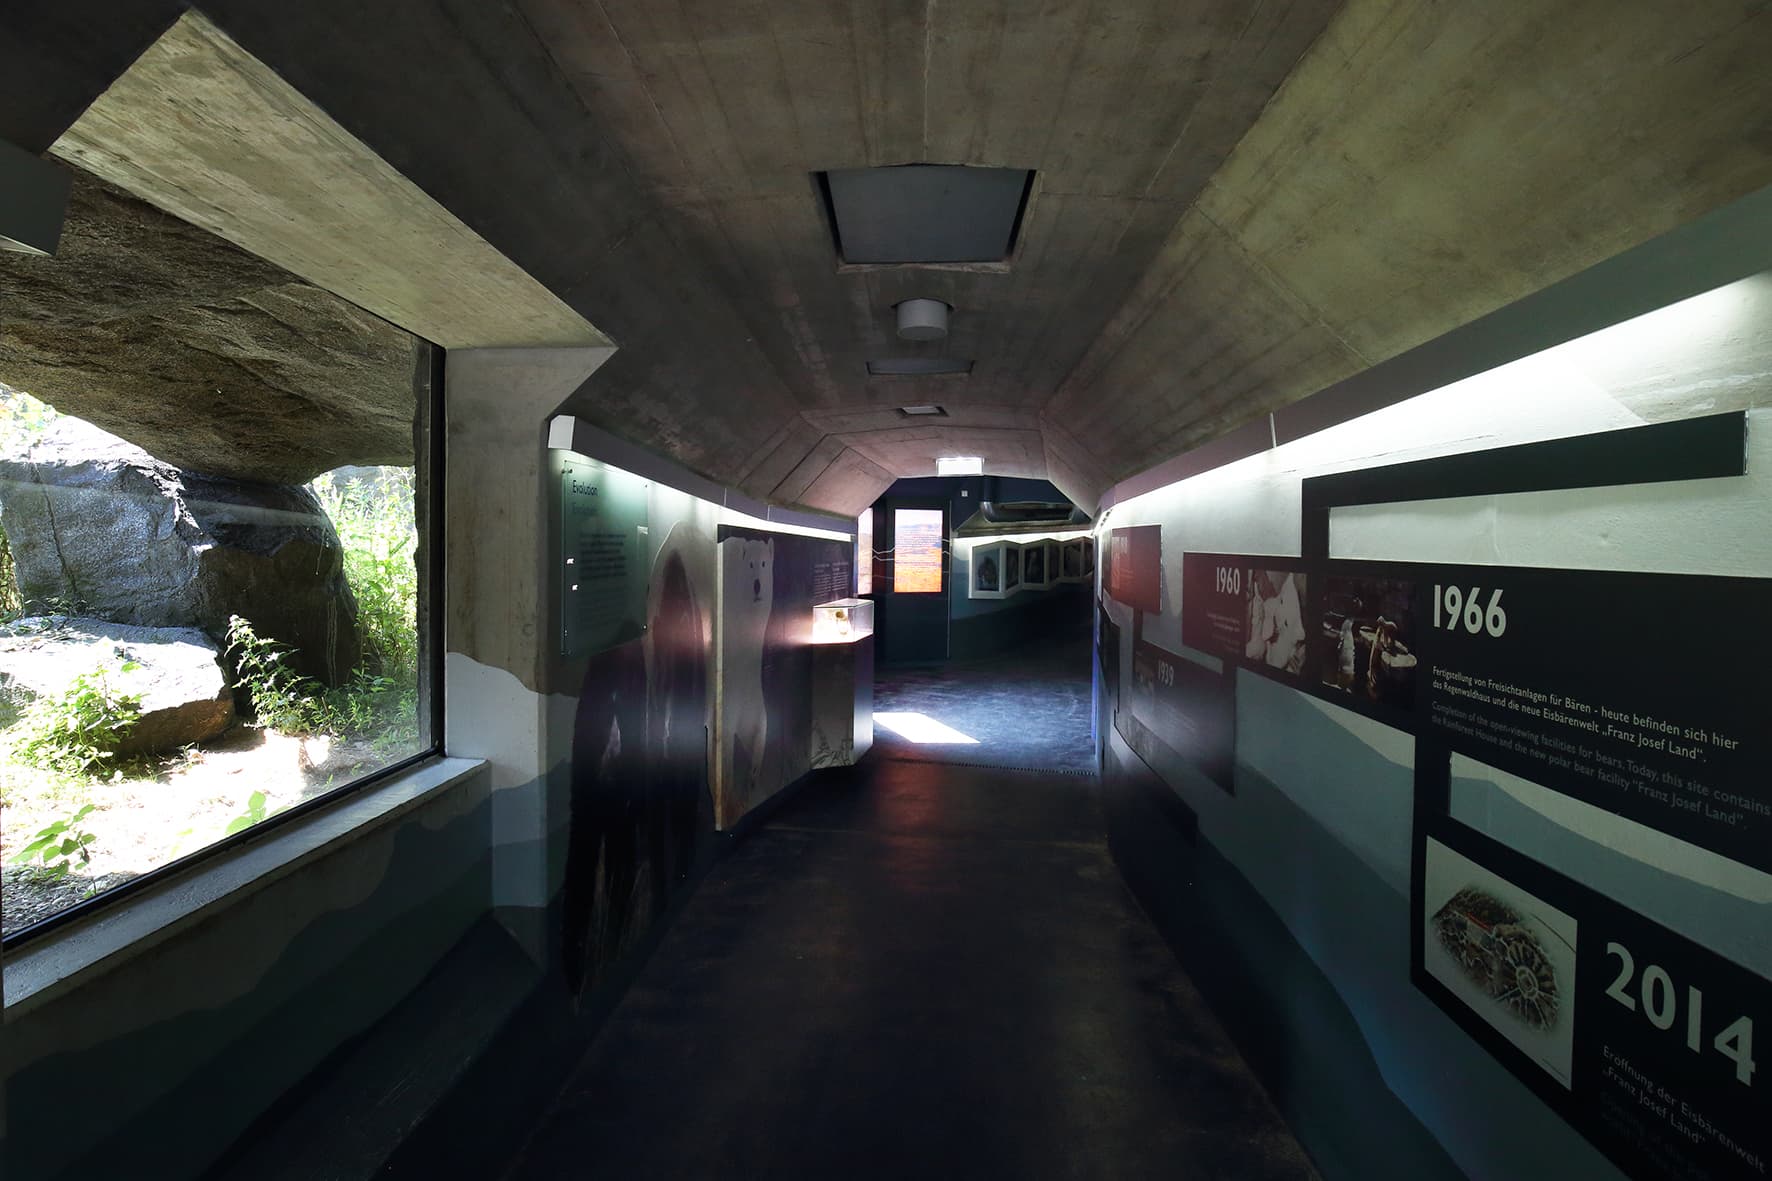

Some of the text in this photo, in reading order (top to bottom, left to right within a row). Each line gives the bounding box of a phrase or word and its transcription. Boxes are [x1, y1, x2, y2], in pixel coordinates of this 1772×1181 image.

[573, 480, 599, 497] Evolution
[1216, 567, 1240, 595] 1960
[1433, 584, 1507, 639] 1966
[1157, 660, 1175, 687] 1939
[1432, 680, 1443, 690] das
[1443, 681, 1490, 703] Regenwaldhaus
[1492, 697, 1506, 707] und
[1507, 699, 1520, 711] die
[1520, 705, 1541, 717] neue
[1543, 708, 1599, 733] Eisbärenwelt
[1637, 732, 1666, 750] Josef
[1474, 679, 1487, 688] von
[1488, 679, 1548, 704] Freisichtanlagen
[1550, 693, 1562, 706] für
[1565, 697, 1591, 713] Bären
[1601, 706, 1630, 723] heute
[1632, 713, 1680, 736] befinden
[1684, 728, 1708, 743] sich
[1712, 732, 1739, 750] hier
[1578, 745, 1592, 759] for
[1626, 759, 1659, 783] Today,
[1662, 771, 1682, 788] this
[1687, 780, 1709, 796] site
[1713, 789, 1770, 817] contains
[1670, 792, 1702, 814] Josef
[1604, 941, 1757, 1088] 2014
[1656, 1087, 1676, 1106] der
[1680, 1101, 1766, 1175] Eisbärenwelt
